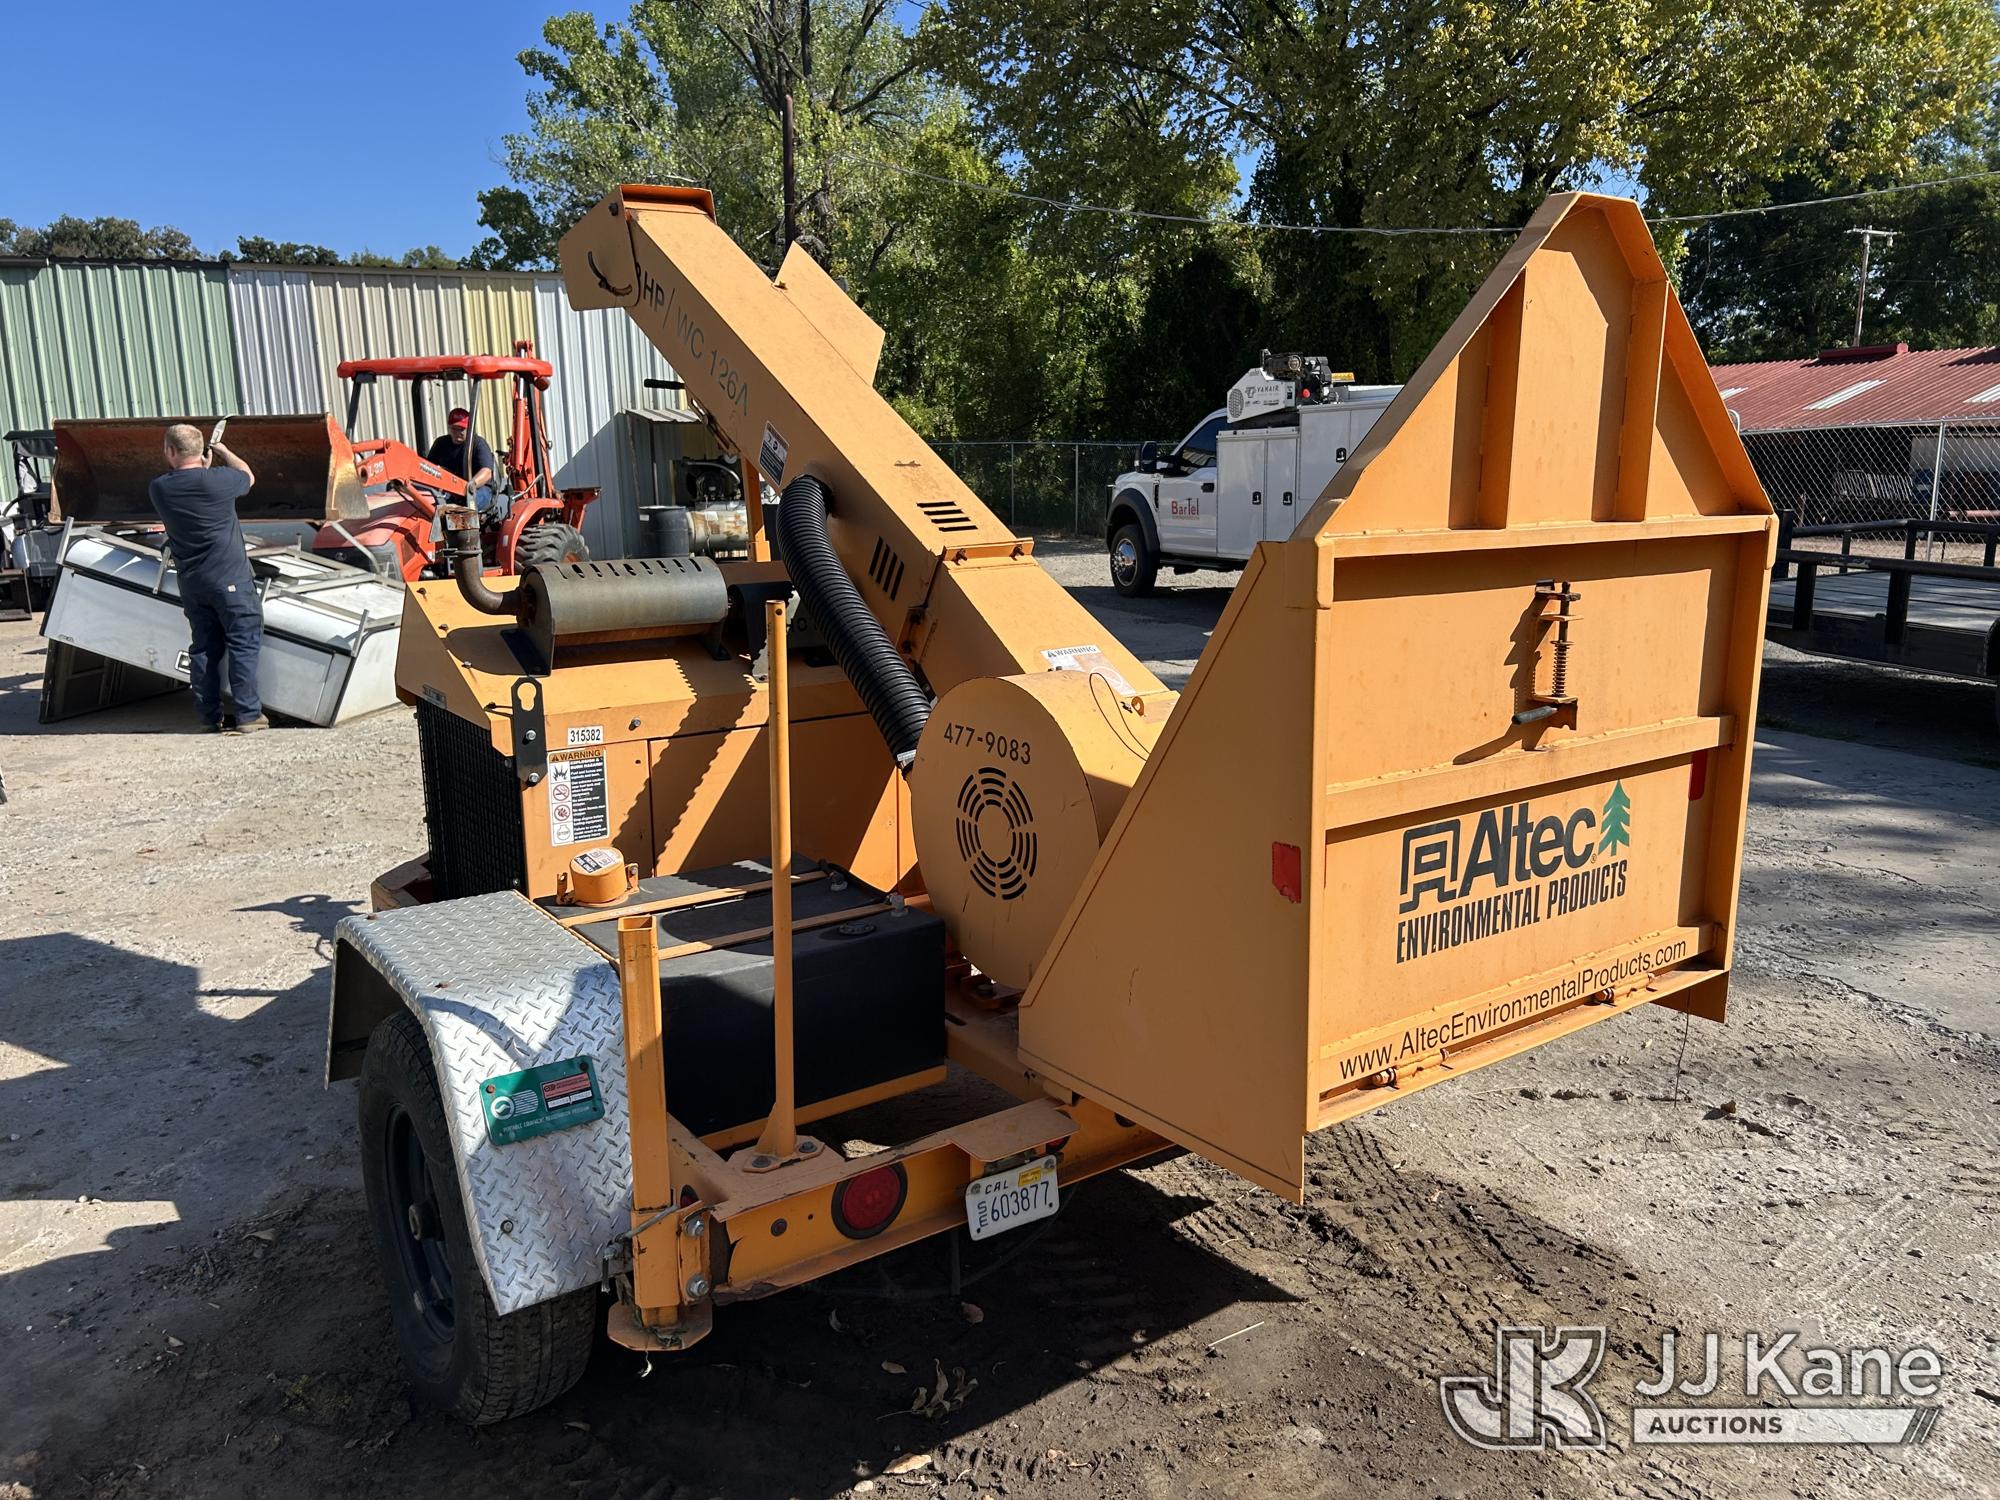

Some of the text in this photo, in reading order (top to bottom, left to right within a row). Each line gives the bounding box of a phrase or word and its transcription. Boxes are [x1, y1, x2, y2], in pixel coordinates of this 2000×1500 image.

[1055, 646, 1097, 656] WARNING
[560, 750, 601, 761] WARNING
[570, 729, 601, 742] 315382
[944, 723, 1031, 764] 477-9083
[1458, 802, 1596, 898] Altec
[1397, 860, 1628, 963] ENVIRONMENTAL PRODUCTS
[1340, 939, 1687, 1080] www.AltecEnvironmentalProducts.com
[985, 1180, 1008, 1194] CAL
[991, 1181, 1049, 1221] 603877
